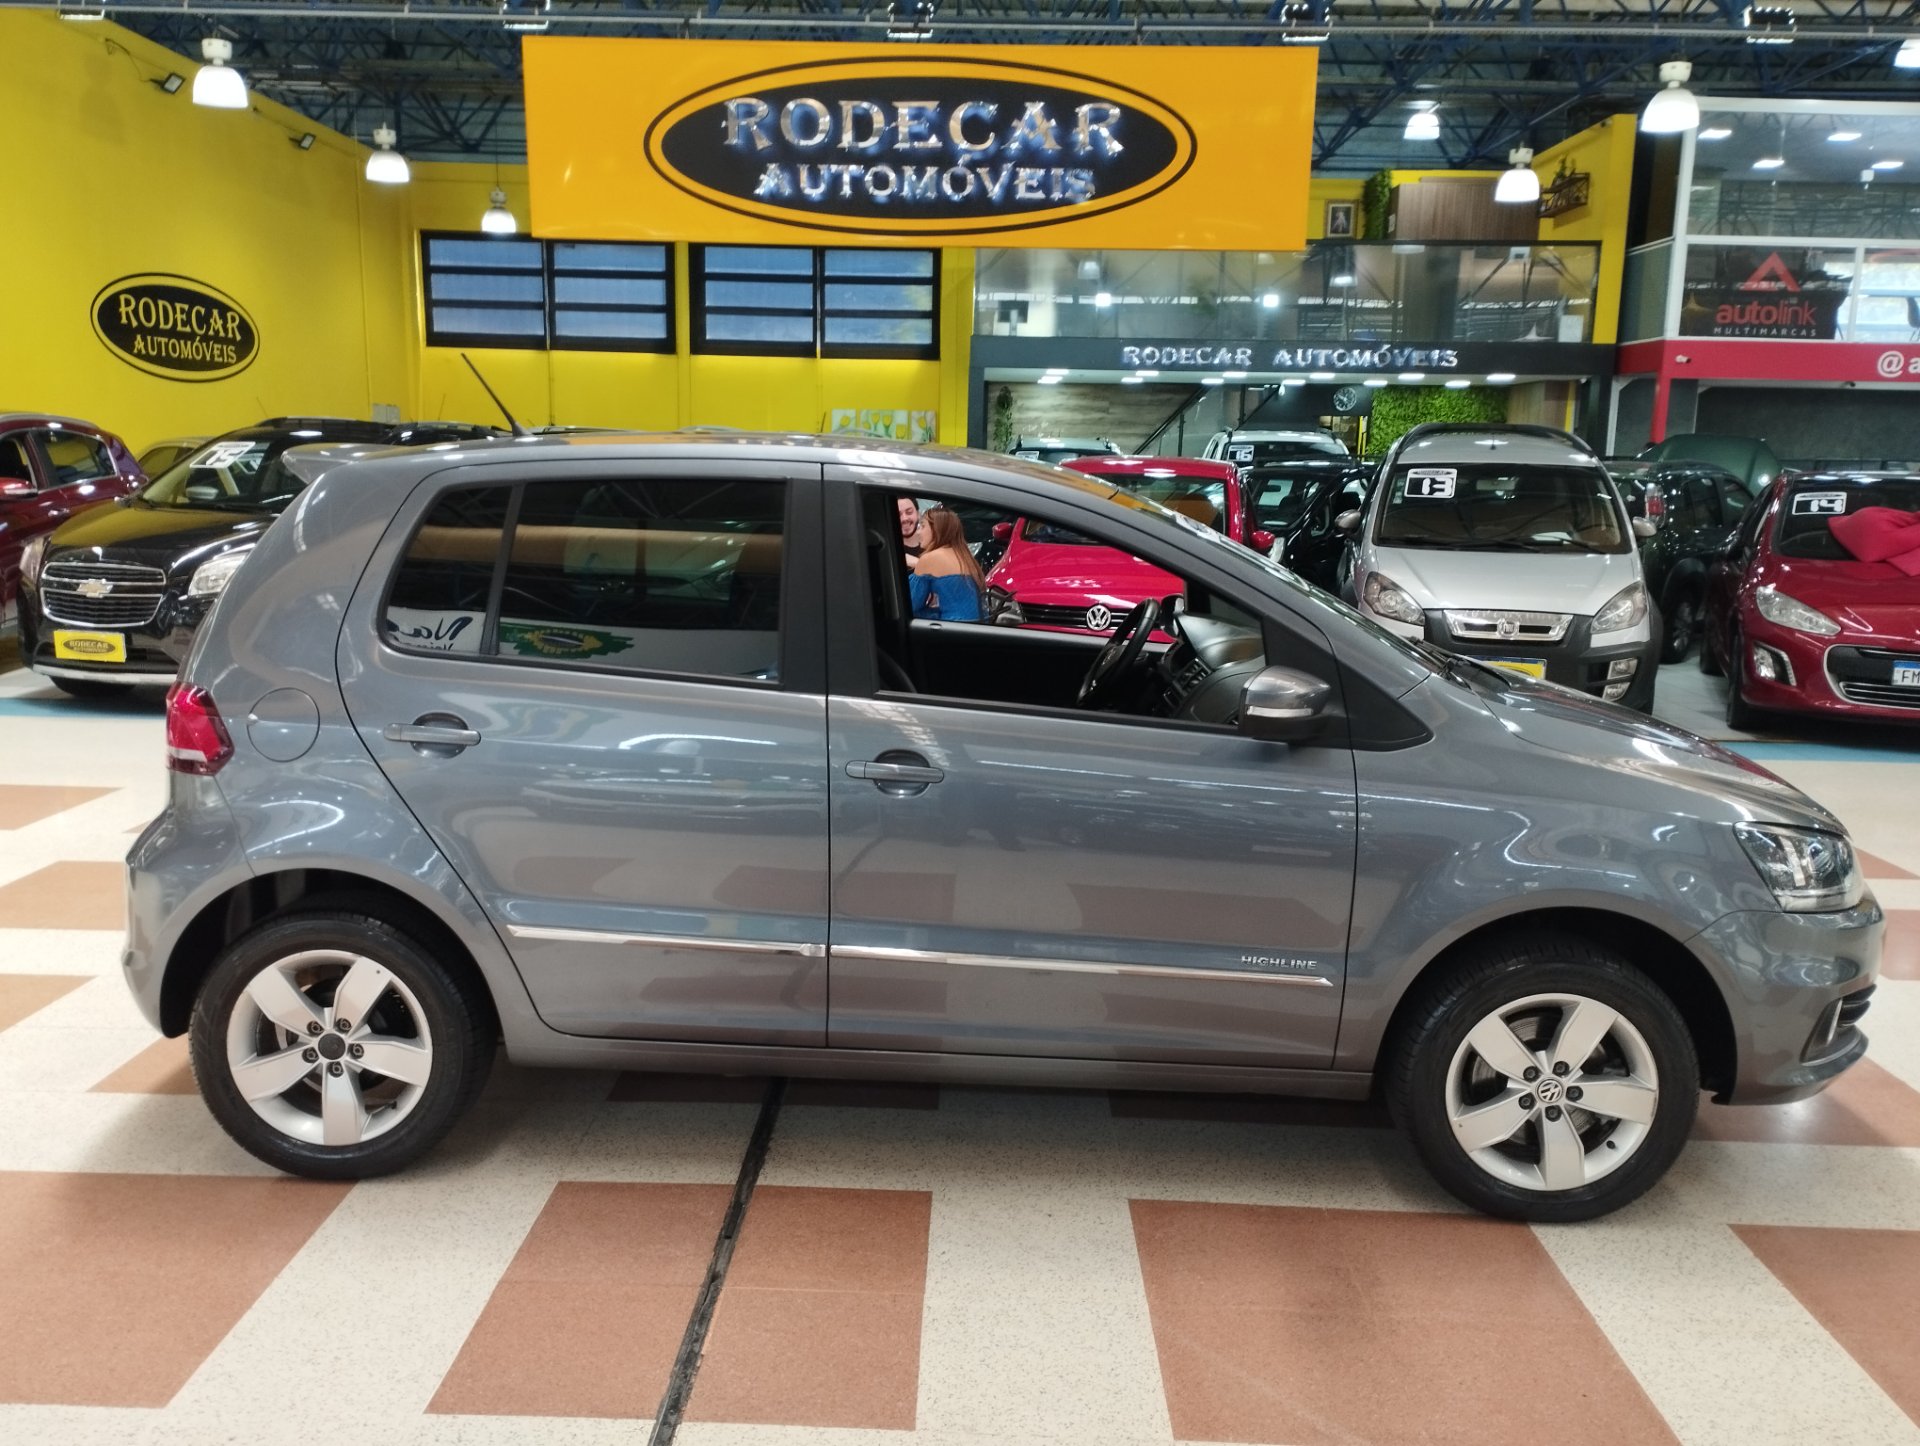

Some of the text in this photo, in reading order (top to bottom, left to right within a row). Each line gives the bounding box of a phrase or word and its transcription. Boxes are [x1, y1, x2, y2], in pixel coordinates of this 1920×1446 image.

[721, 97, 1126, 156] RODECAR
[753, 154, 1098, 200] AUTOMÓVEIS
[118, 293, 242, 342] RODECAR
[1715, 299, 1817, 326] autolink
[1713, 326, 1817, 337] MULTIMARCAS
[133, 333, 238, 364] AUTOMÓVEIS
[1122, 343, 1459, 368] RODECAR AUTOMÓVEIS
[1421, 477, 1453, 496] 13
[1810, 499, 1843, 512] 14
[1241, 955, 1317, 970] HIGHLINE
